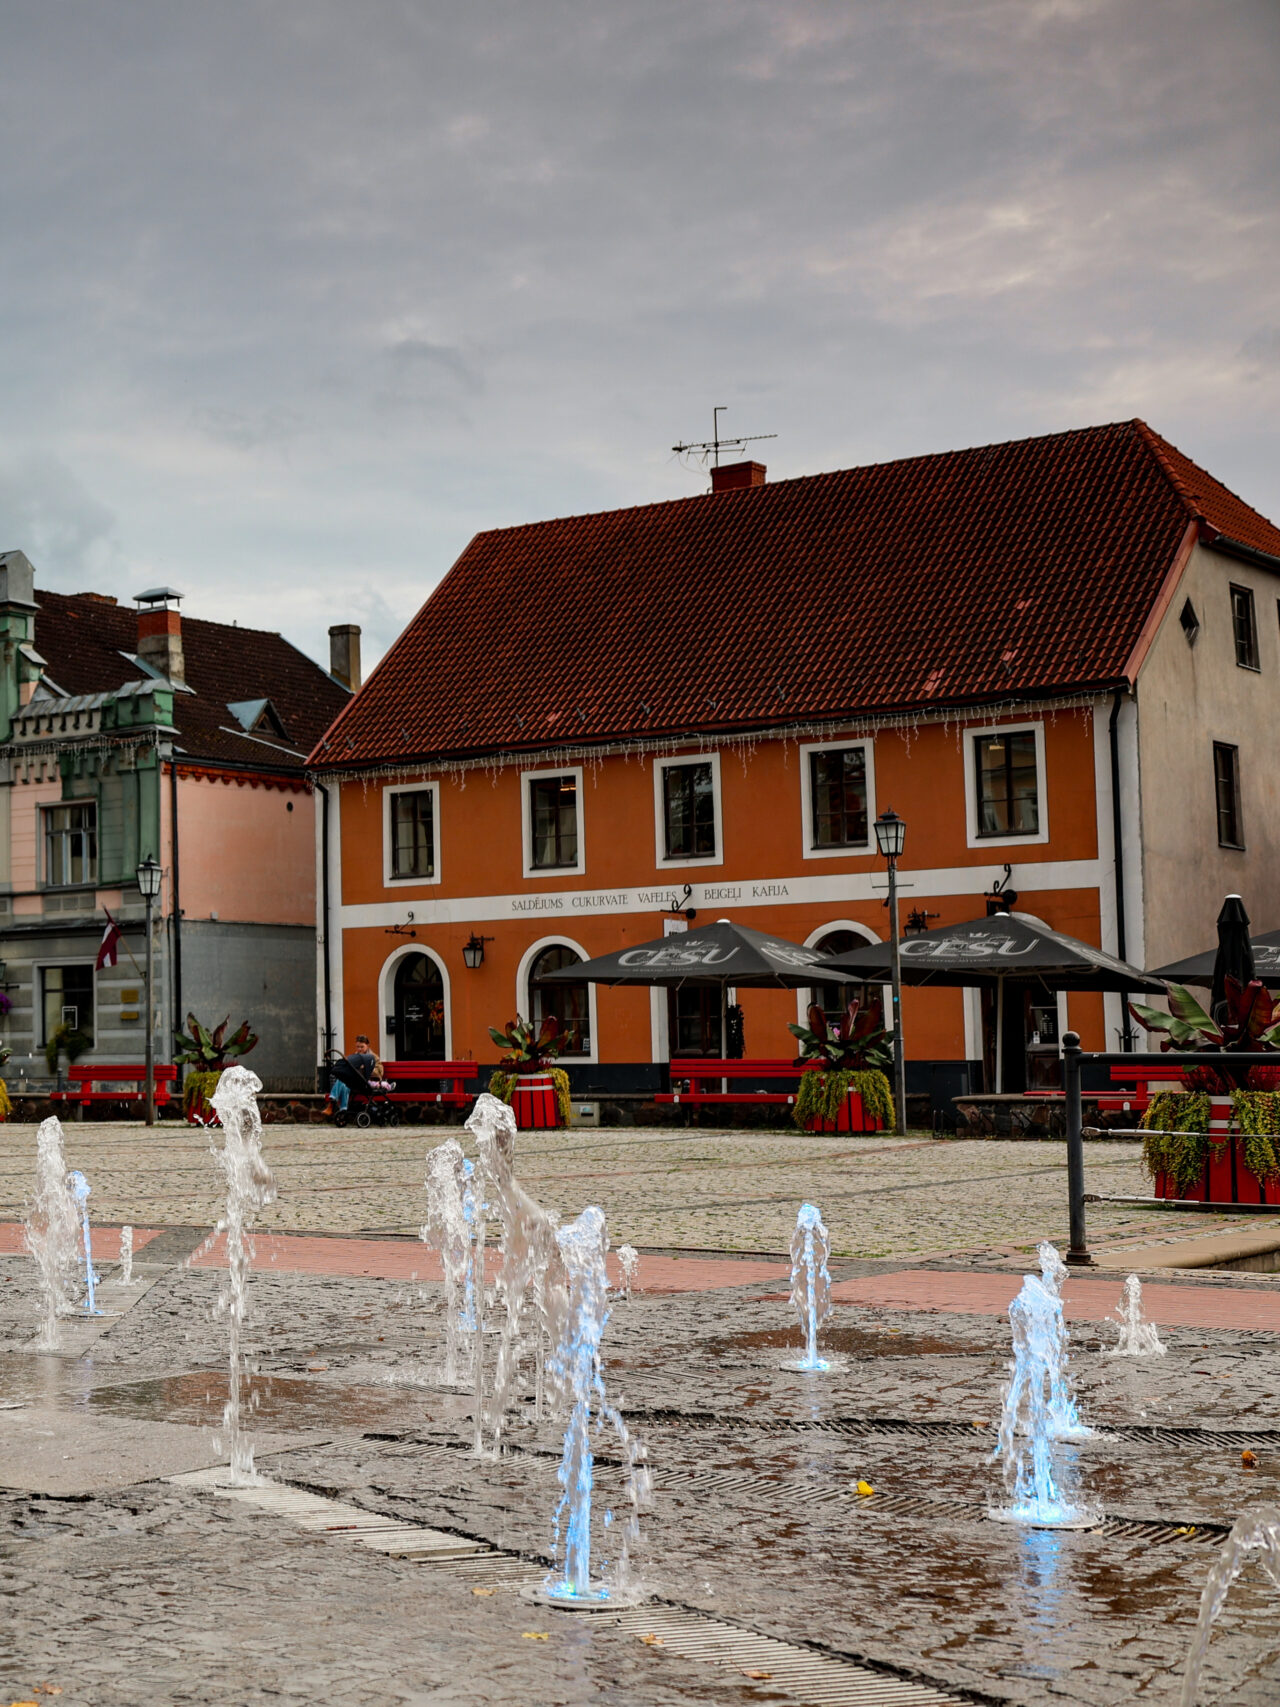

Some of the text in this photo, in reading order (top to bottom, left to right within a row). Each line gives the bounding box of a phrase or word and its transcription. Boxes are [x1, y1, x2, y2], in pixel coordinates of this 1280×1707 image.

[511, 885, 790, 911] SALDĒJUMS CUKURVATE VAFELES BEIGEĻI KAFIJA
